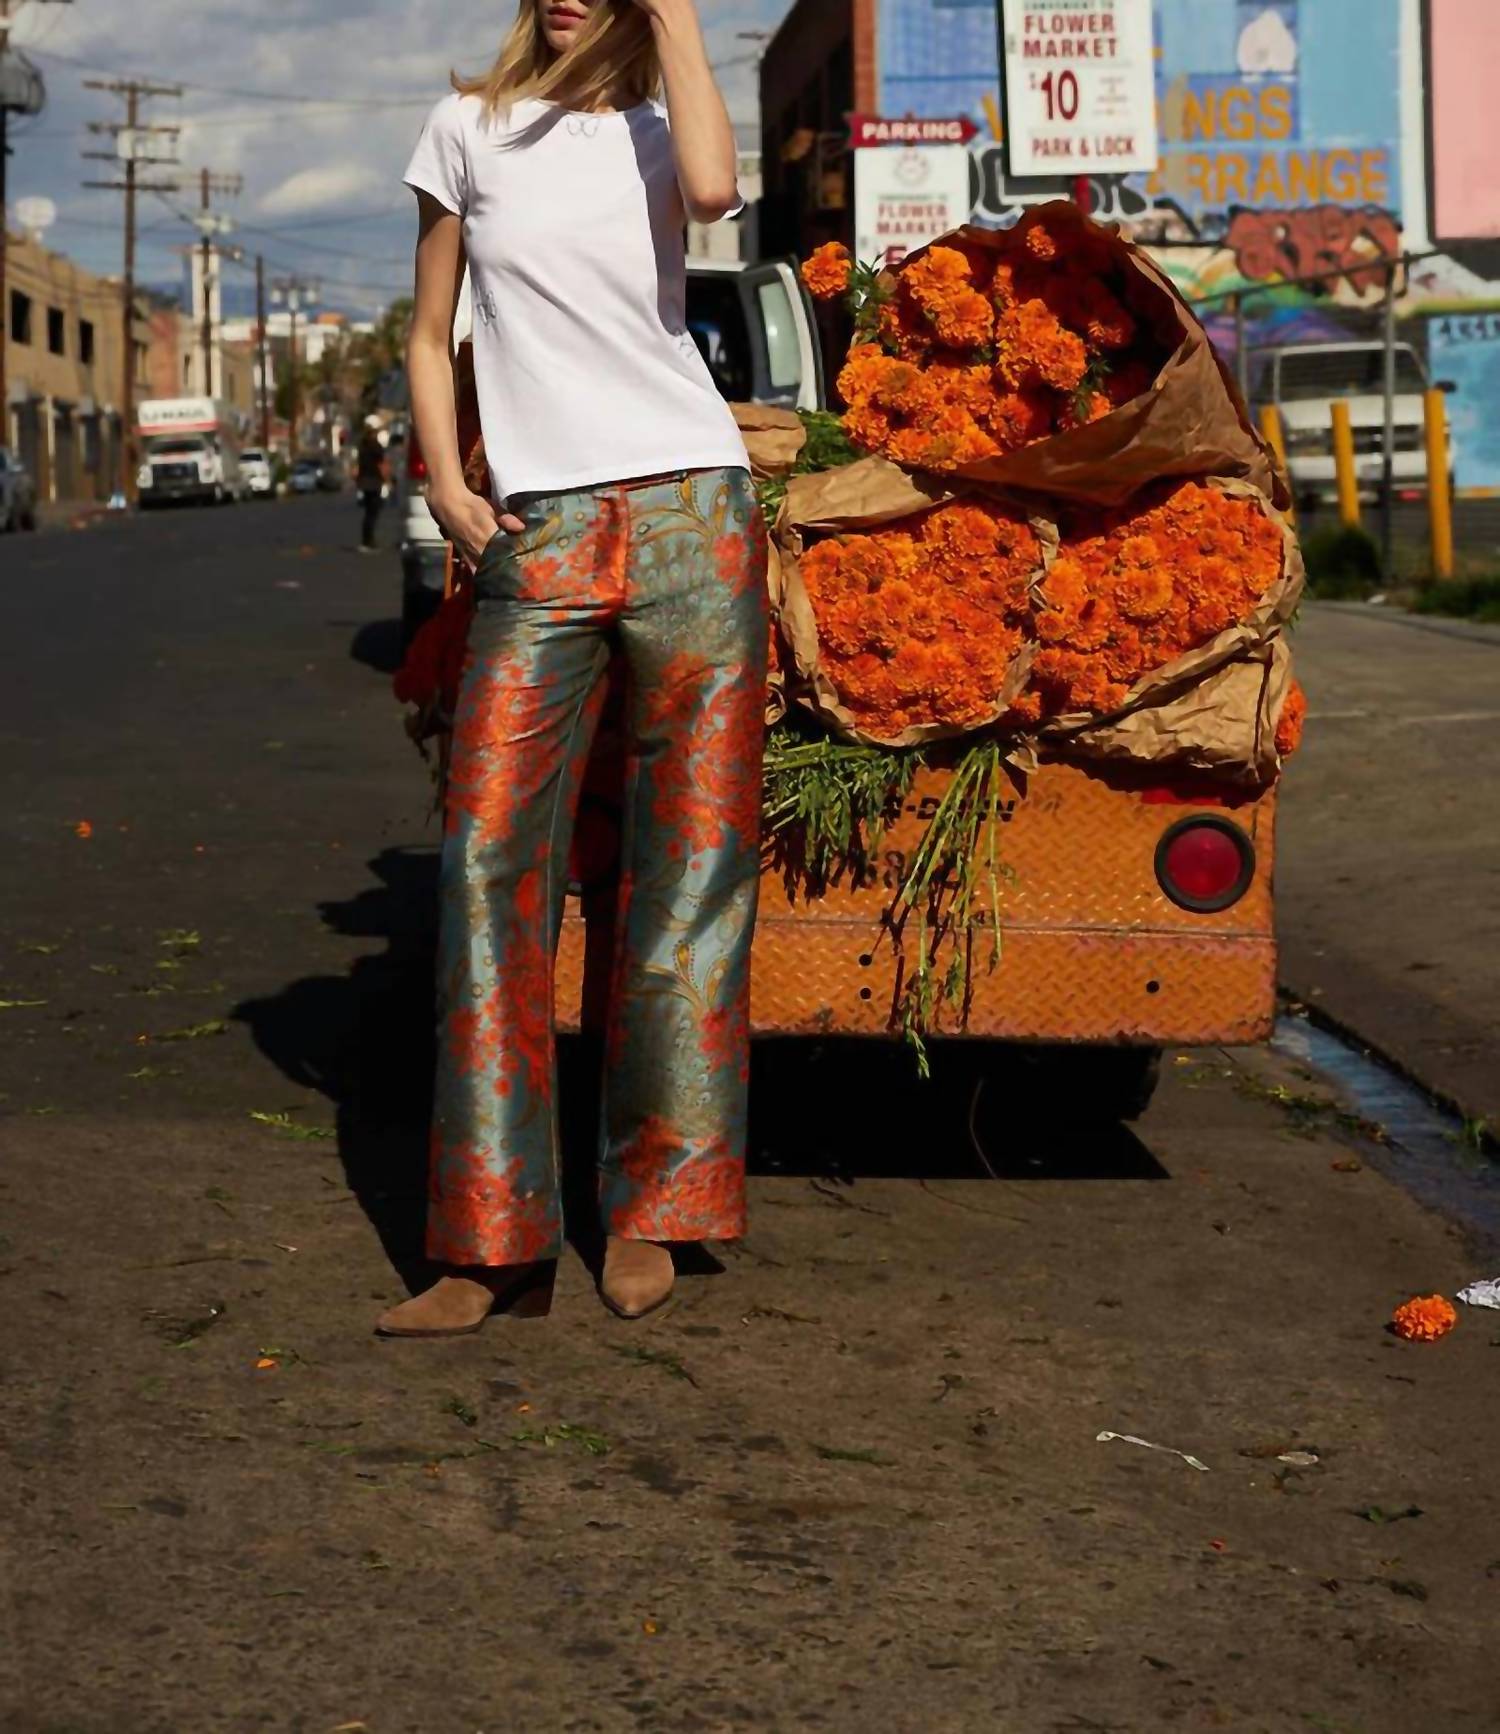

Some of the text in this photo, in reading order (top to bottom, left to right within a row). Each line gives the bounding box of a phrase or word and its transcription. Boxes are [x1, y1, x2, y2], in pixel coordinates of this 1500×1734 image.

[1024, 14, 1114, 33] FLOWER
[1023, 39, 1116, 57] MARKET
[862, 122, 963, 139] PARKING
[1032, 138, 1072, 156] PARK
[1096, 136, 1133, 156] LOCK
[878, 204, 947, 217] FLOWER
